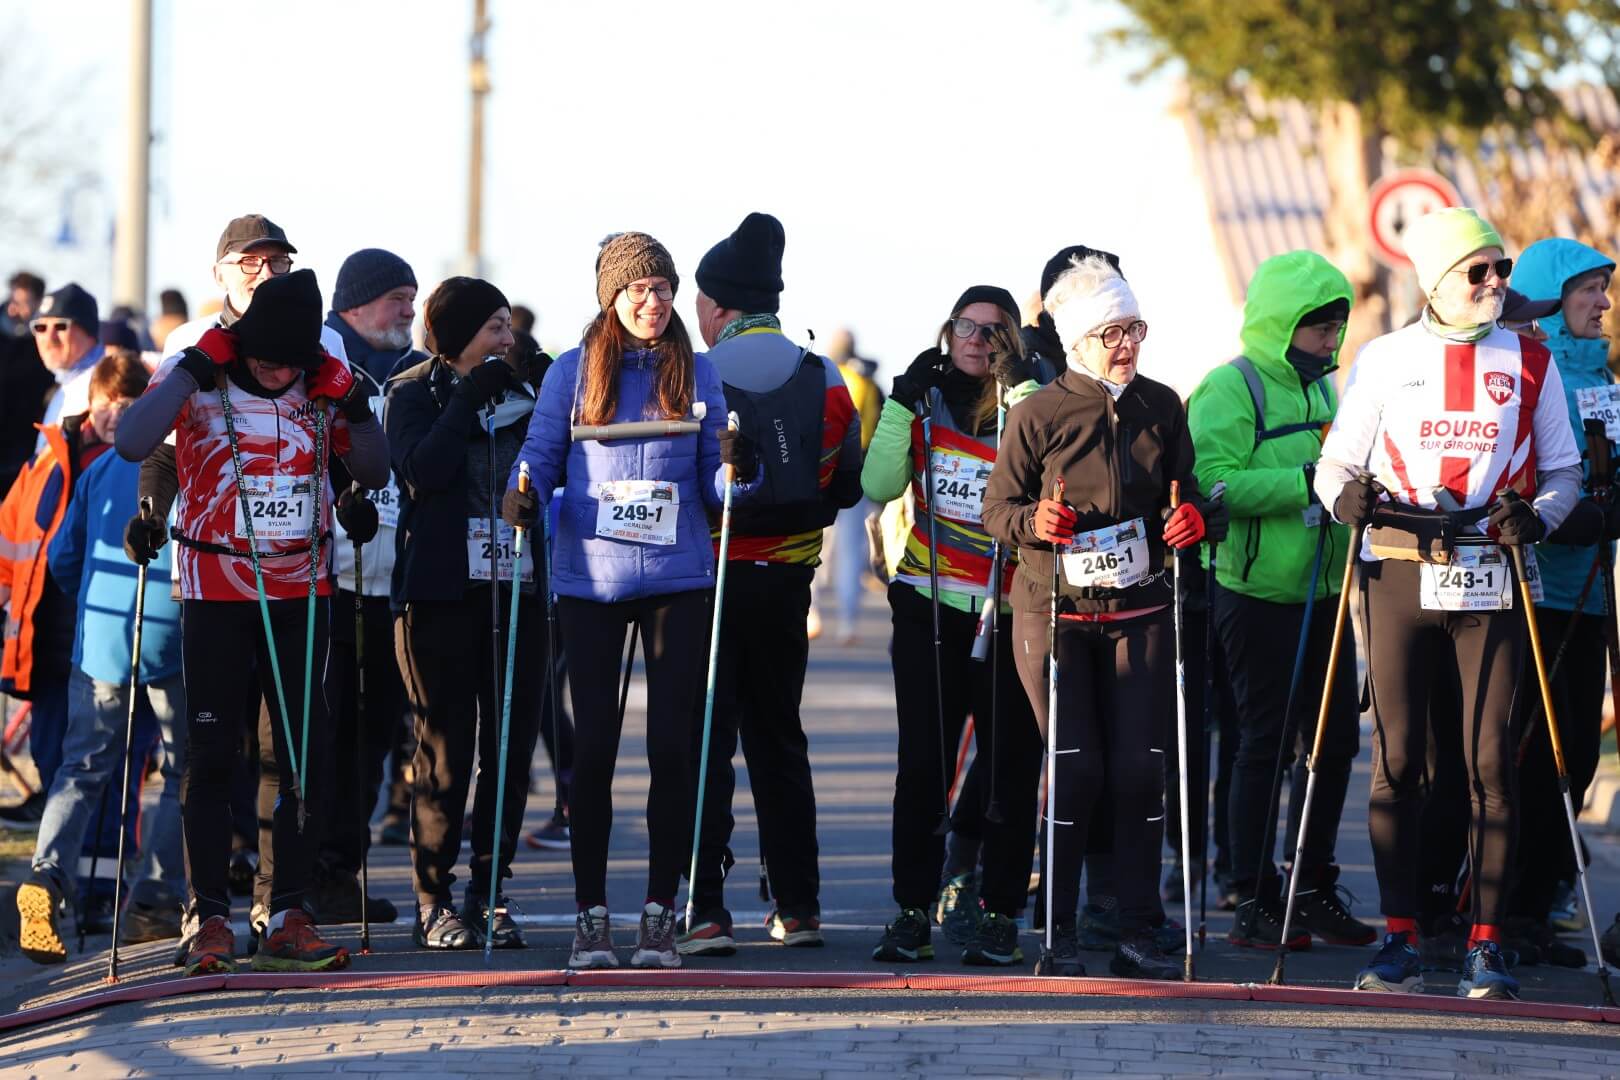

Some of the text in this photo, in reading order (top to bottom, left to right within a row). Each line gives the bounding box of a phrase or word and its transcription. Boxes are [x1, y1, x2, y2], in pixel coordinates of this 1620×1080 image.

[1420, 420, 1499, 439] BOURG
[774, 418, 789, 463] EVADICT
[1420, 441, 1499, 453] SUR GIRONDE
[936, 478, 986, 503] 244-1
[253, 500, 303, 518] 242-1
[612, 504, 663, 523] 249-1
[945, 499, 975, 510] CHRISTINE
[1082, 546, 1134, 575] 246-1
[1440, 570, 1493, 589] 243-1
